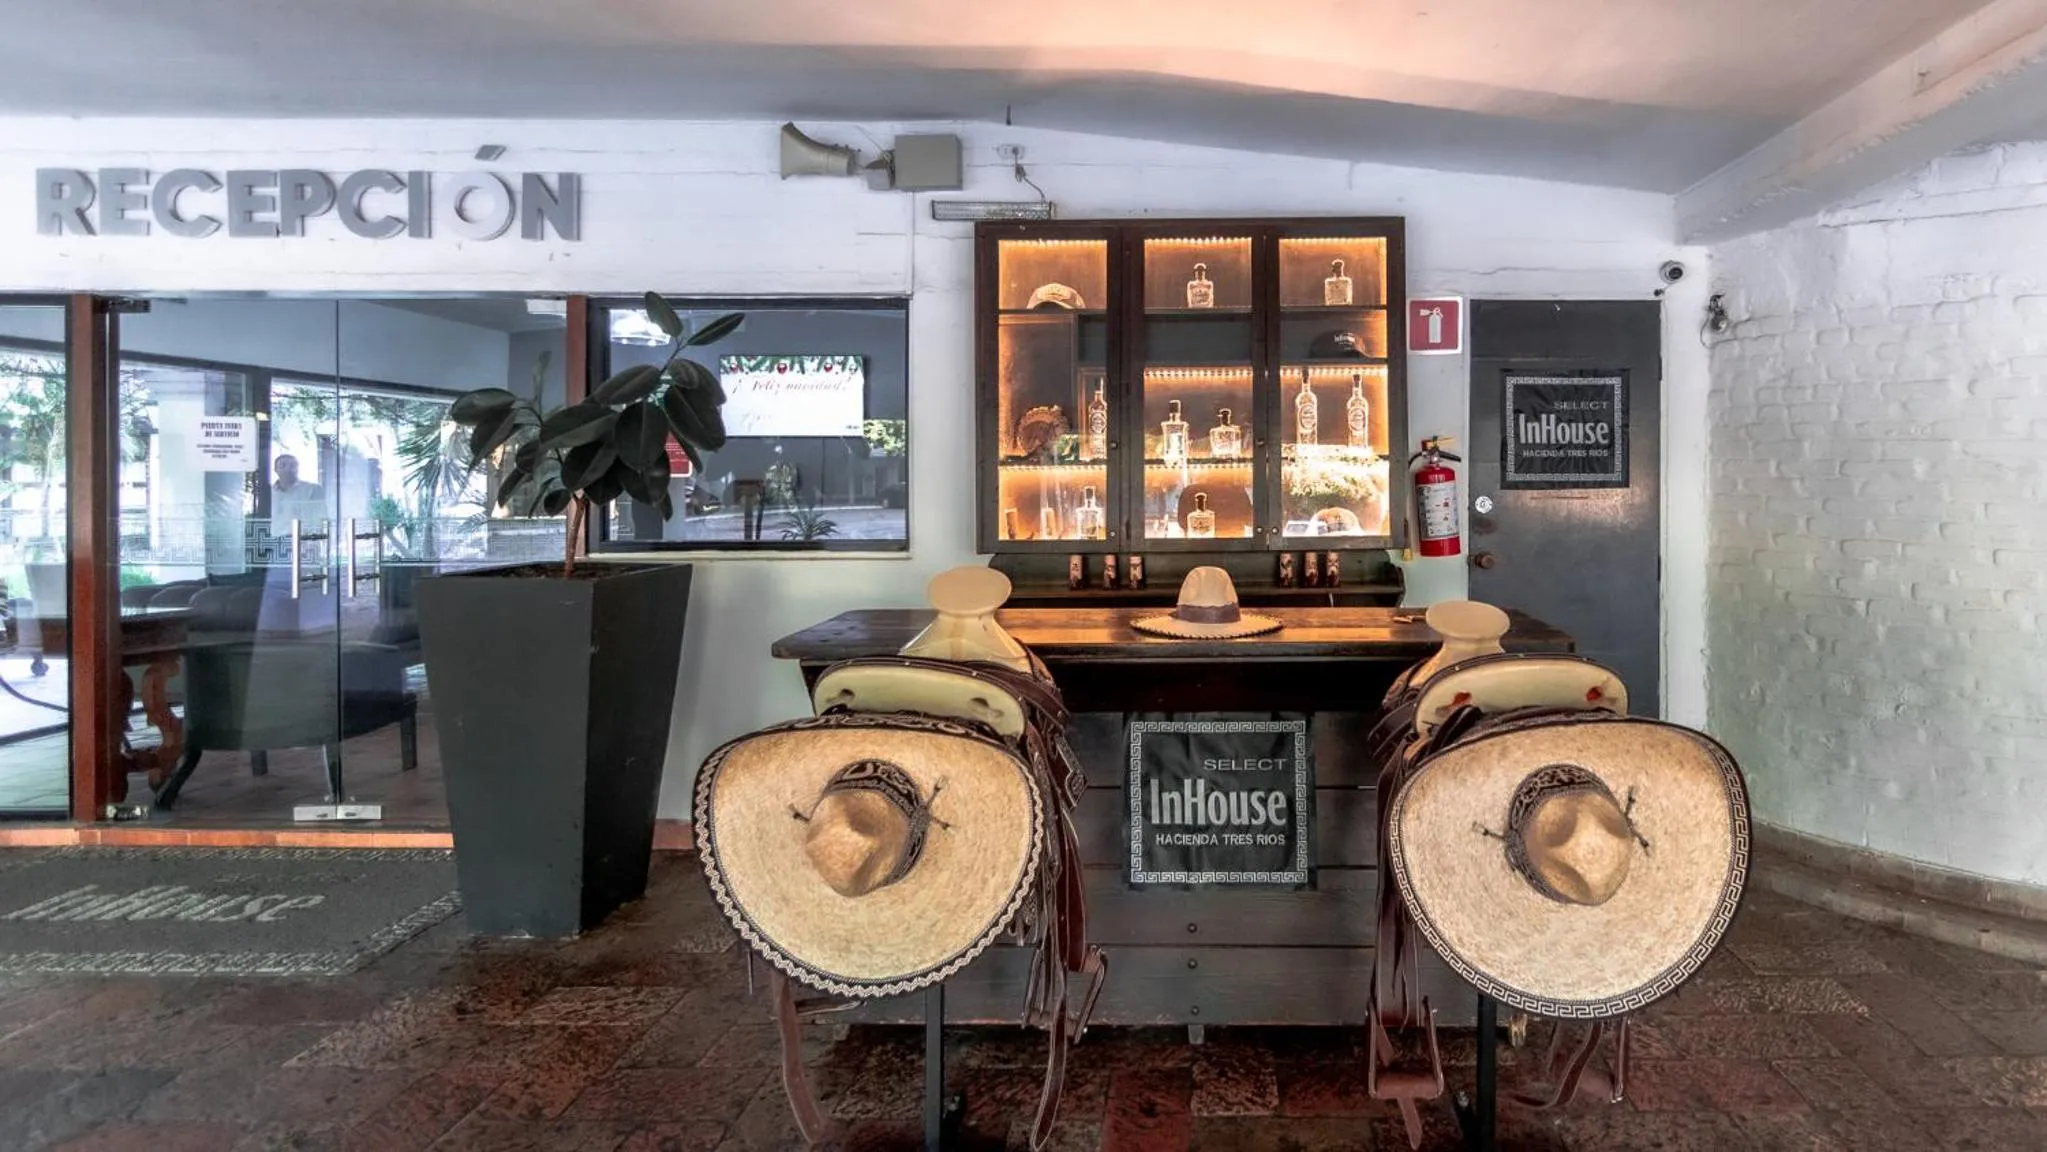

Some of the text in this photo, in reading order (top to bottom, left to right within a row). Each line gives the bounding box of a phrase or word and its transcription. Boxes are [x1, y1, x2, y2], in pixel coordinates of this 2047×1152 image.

[36, 145, 581, 242] RECEPCIÓN
[1553, 400, 1609, 410] SELECT
[1518, 413, 1609, 444] InHouse
[1523, 449, 1564, 458] HACIENDA
[1567, 449, 1587, 457] TRES
[1203, 758, 1289, 771] SELECT
[1150, 778, 1287, 826] InHouse
[1156, 834, 1286, 845] HACIENDA TRES RIOS
